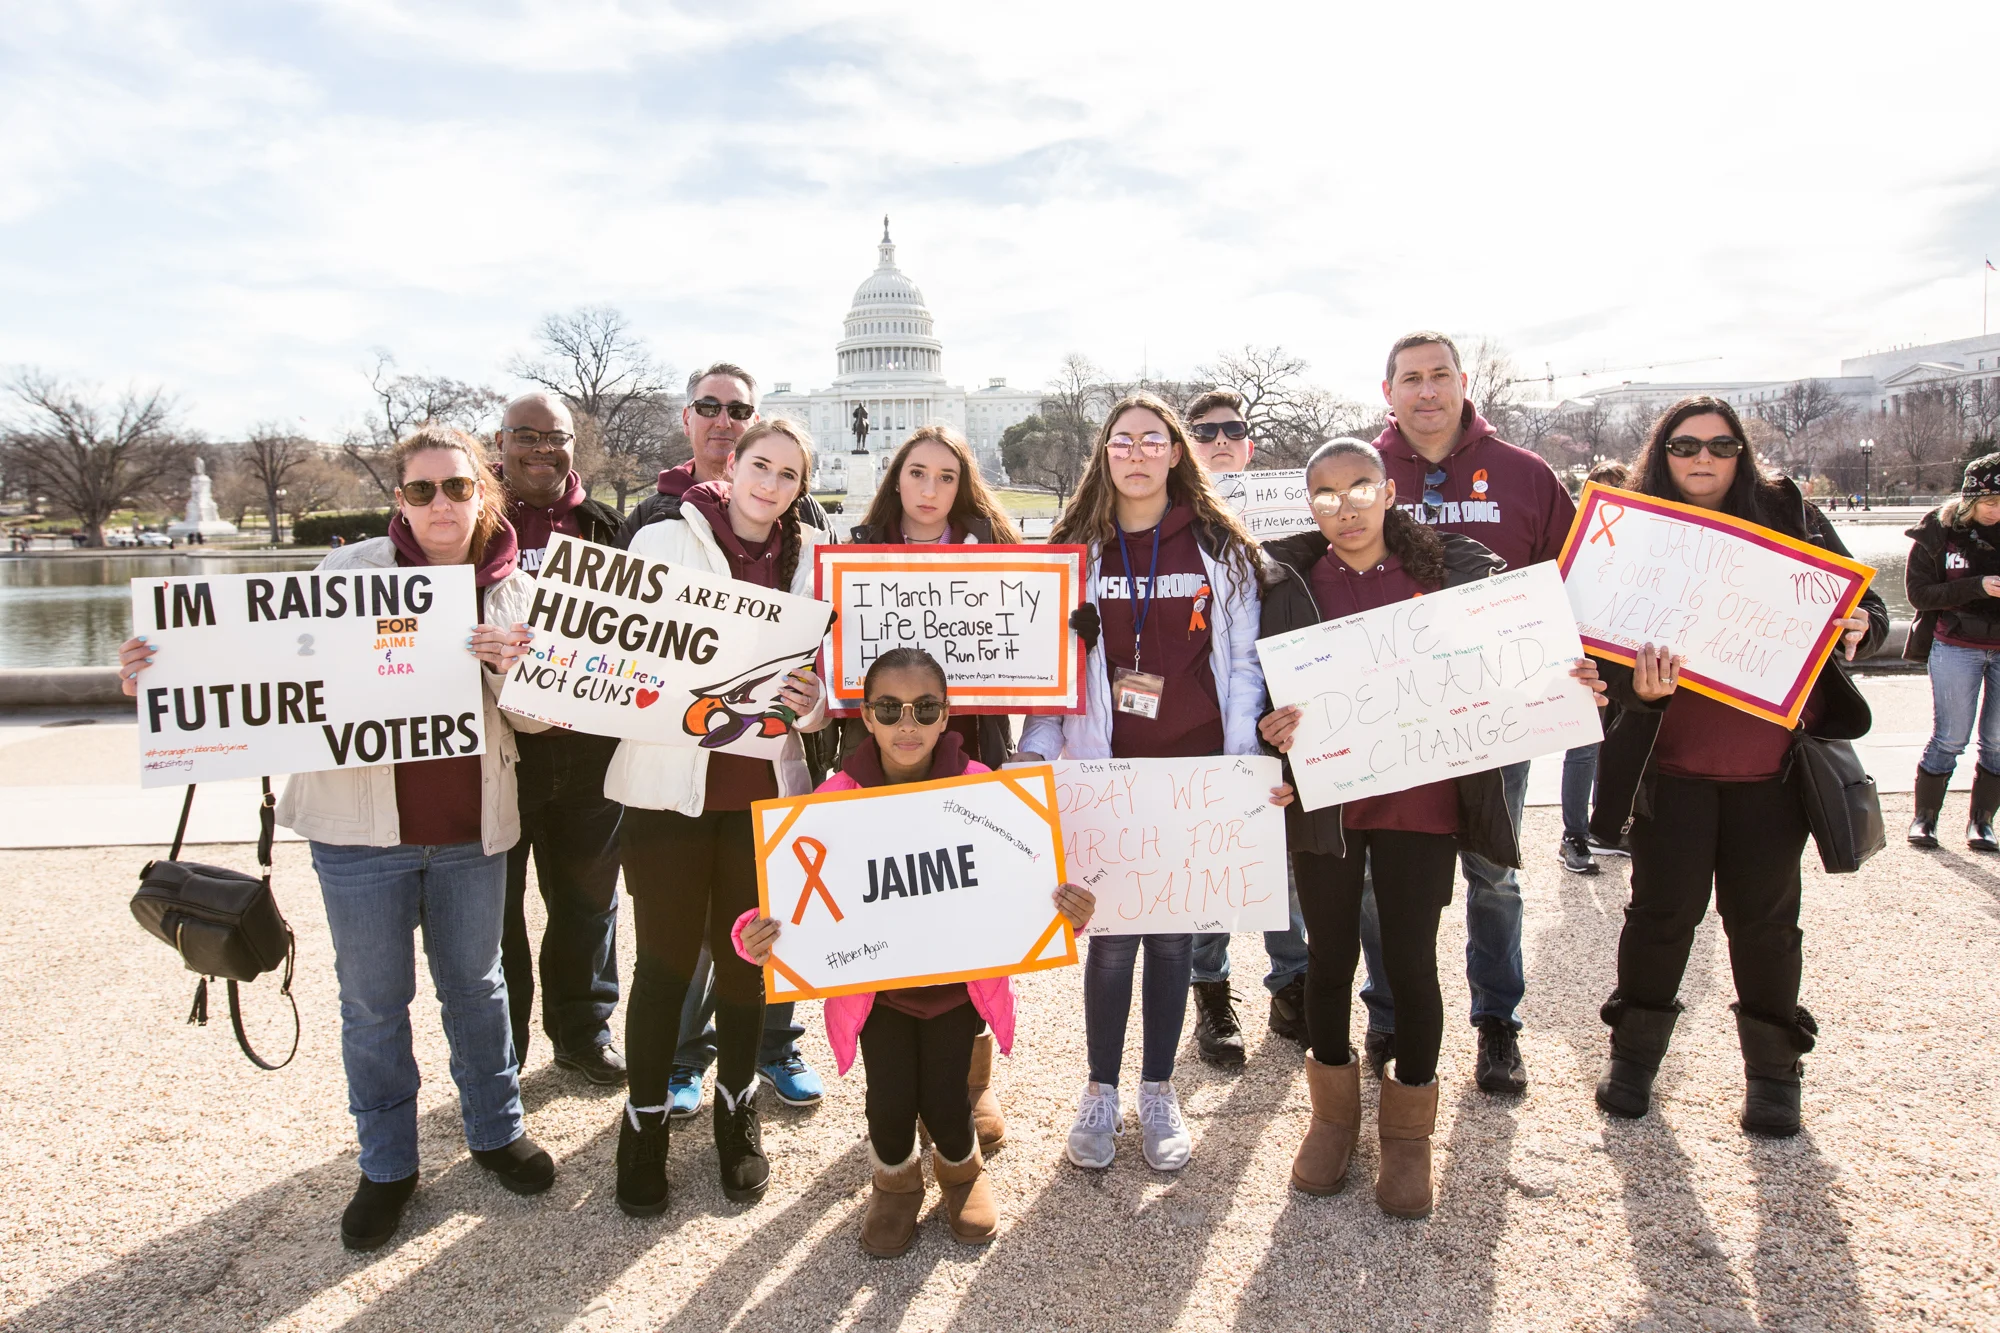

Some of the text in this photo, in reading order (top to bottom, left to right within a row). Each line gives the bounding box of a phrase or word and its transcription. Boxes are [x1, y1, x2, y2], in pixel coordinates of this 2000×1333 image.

[1256, 487, 1308, 502] HAS GOT
[543, 540, 669, 603] ARMS
[675, 584, 730, 611] ARE
[733, 596, 782, 623] FOR
[1790, 572, 1842, 605] MSD
[154, 574, 433, 630] I'M RAISING
[852, 580, 1040, 623] I March For My
[1465, 605, 1486, 617] Jaime
[1620, 560, 1668, 596] OUR
[1679, 576, 1704, 610] 16
[1718, 592, 1814, 649] OTHERS
[377, 618, 418, 635] FOR
[527, 588, 719, 665] HUGGING
[860, 610, 1019, 641] Life Because I
[1355, 603, 1440, 664] WE
[1593, 591, 1783, 677] NEVER AGAIN
[297, 633, 315, 656] 2
[373, 636, 416, 651] JAIME
[525, 645, 578, 668] rotect
[944, 640, 975, 663] Run
[978, 639, 1000, 661] For
[1004, 639, 1020, 661] it
[378, 663, 415, 676] CARA
[147, 680, 326, 733] FUTURE
[573, 675, 635, 706] GUNS
[1313, 637, 1545, 744] DEMAND
[1450, 705, 1468, 716] Chris
[322, 712, 479, 766] VOTERS
[1369, 706, 1531, 773] CHANGE
[1080, 762, 1104, 774] Best
[1232, 760, 1254, 777] Fun
[1305, 757, 1322, 767] Alex
[1168, 767, 1224, 810] WE
[1064, 819, 1258, 868] ARCH FOR
[863, 844, 979, 903] JAIME
[1193, 919, 1223, 932] Loving
